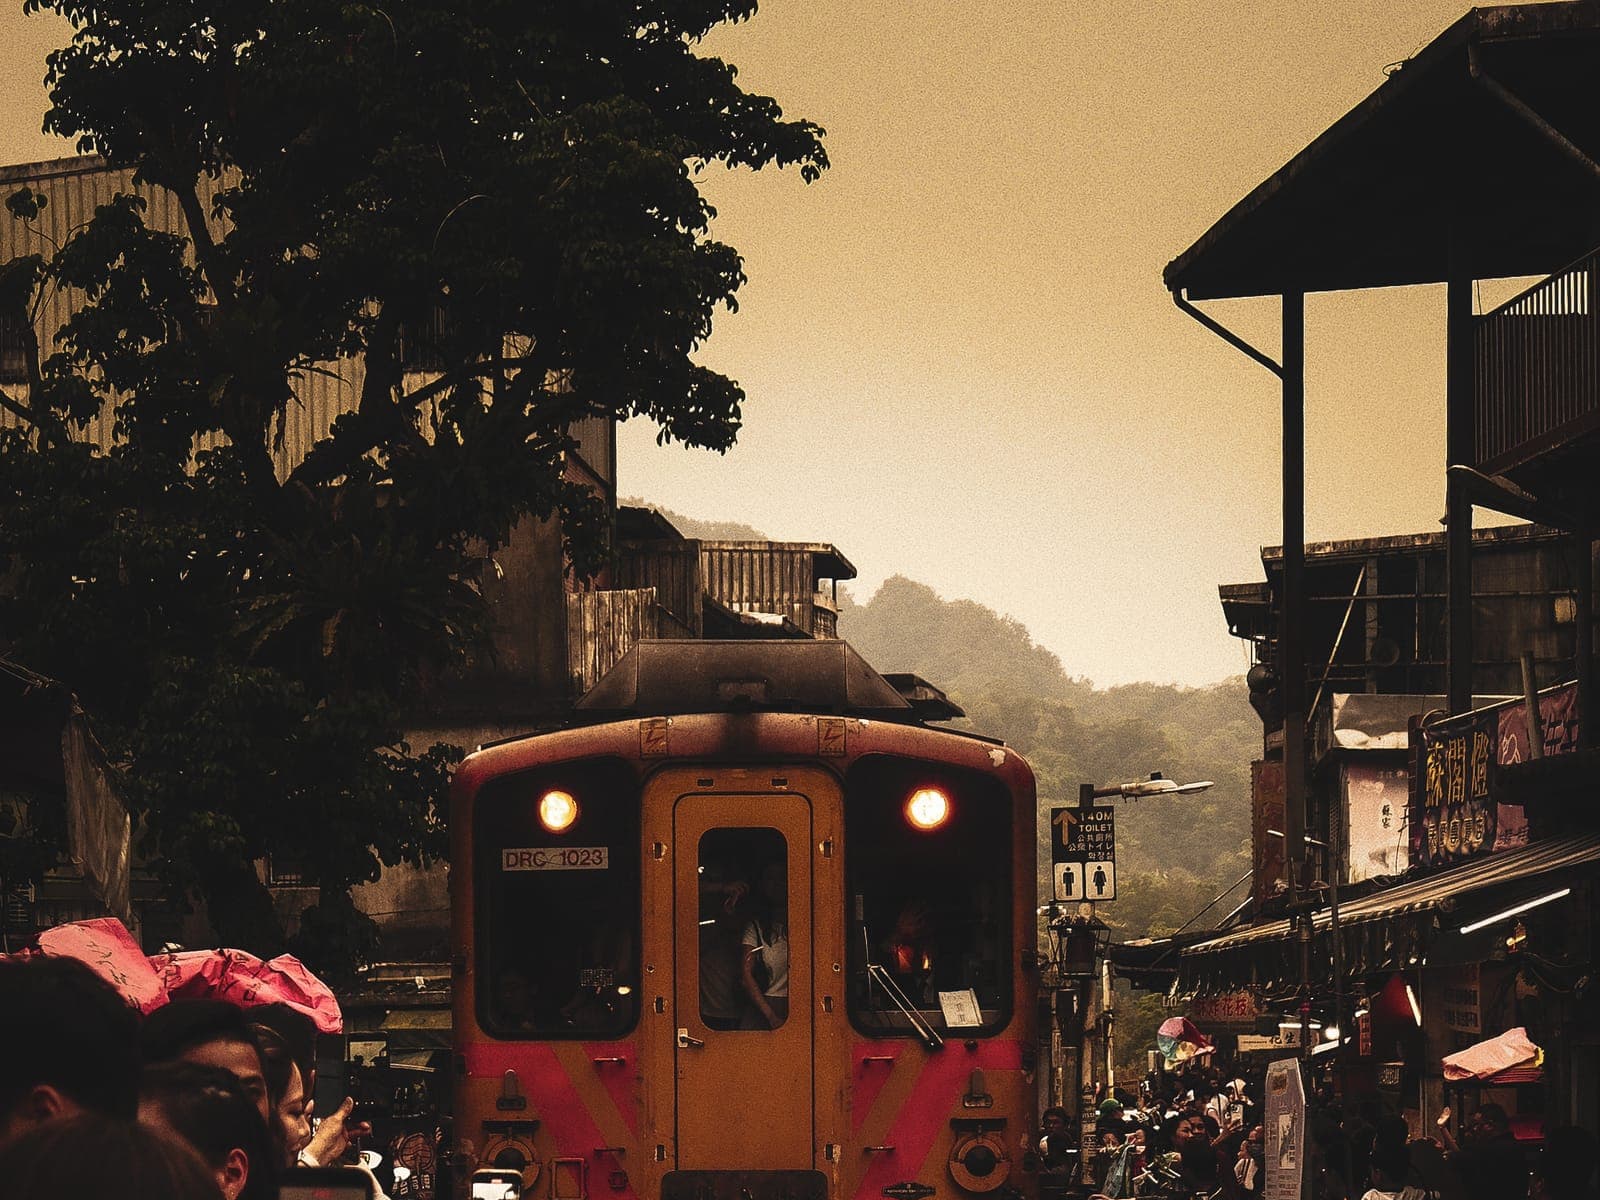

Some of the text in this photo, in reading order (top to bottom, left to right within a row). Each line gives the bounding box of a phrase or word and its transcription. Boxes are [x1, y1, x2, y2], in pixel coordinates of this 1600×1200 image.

[1080, 811, 1113, 822] 140M
[1079, 823, 1113, 833] TOILET
[505, 849, 603, 868] DRC 1023
